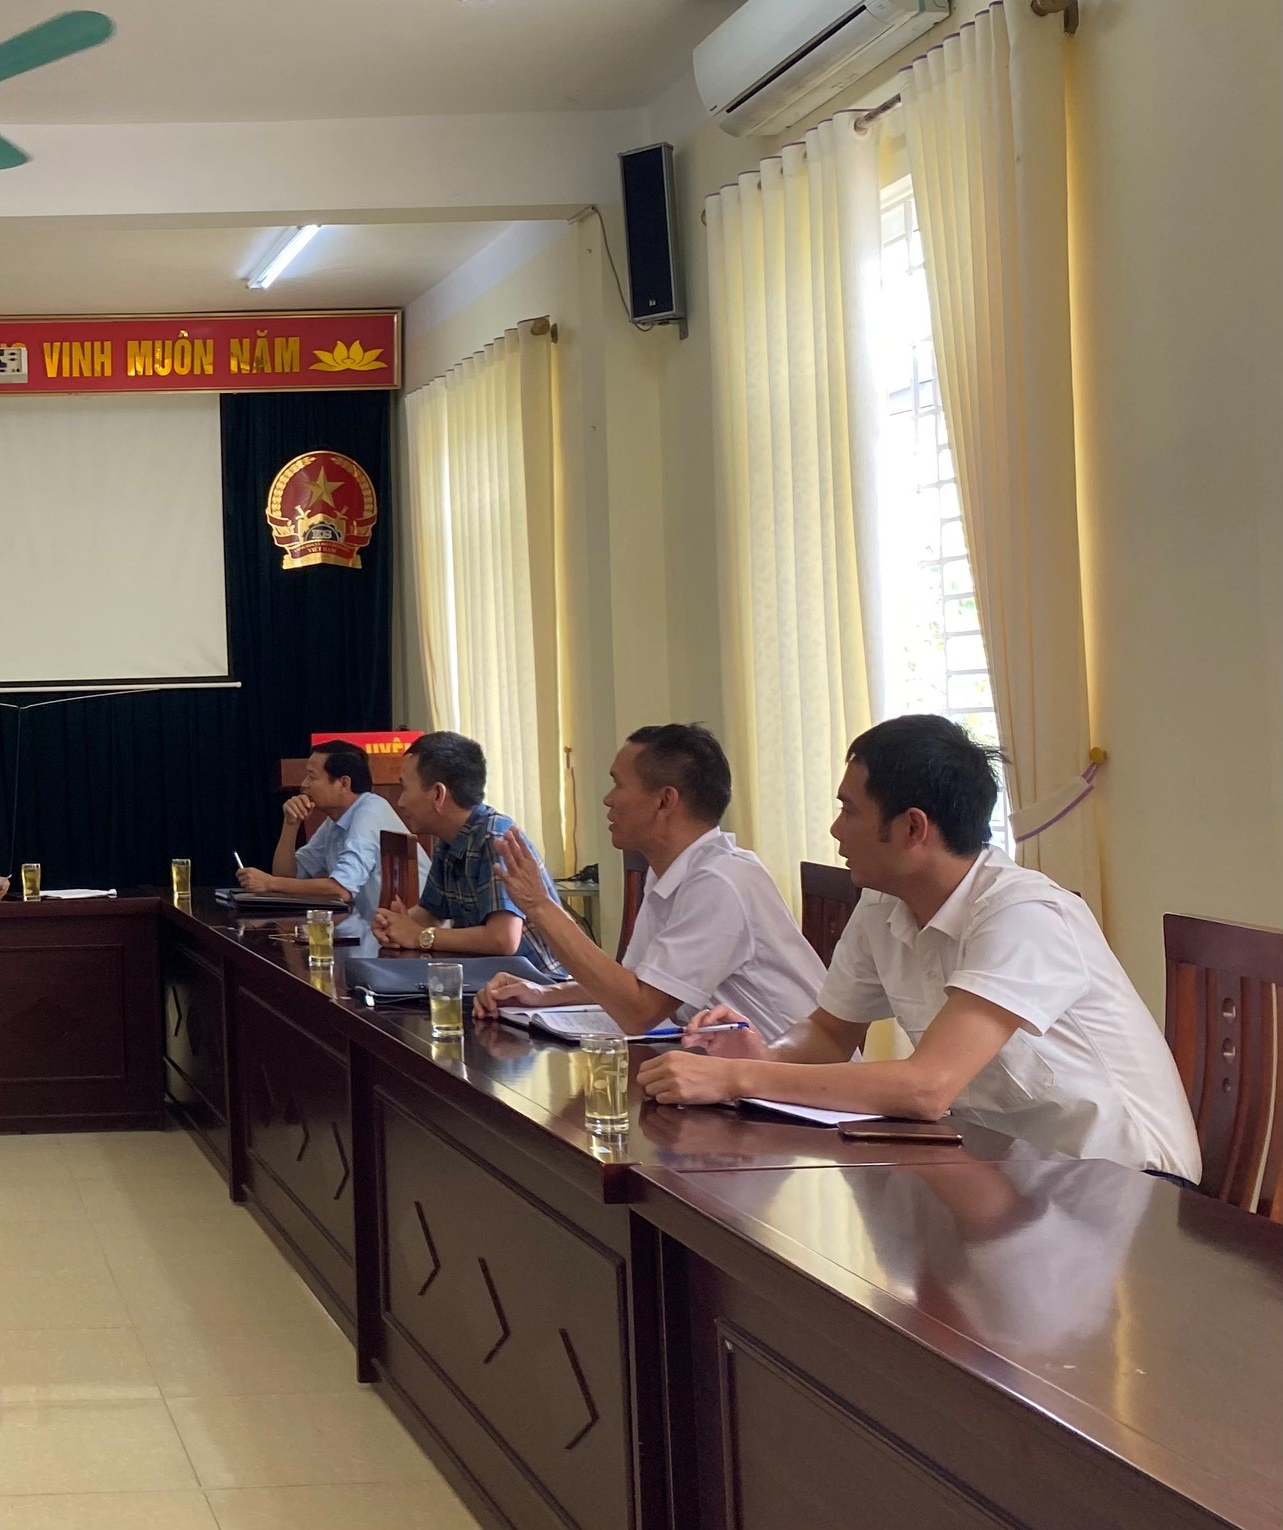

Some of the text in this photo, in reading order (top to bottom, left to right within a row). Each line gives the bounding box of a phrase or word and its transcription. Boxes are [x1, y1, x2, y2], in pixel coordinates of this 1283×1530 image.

[43, 340, 112, 378] VINH
[126, 328, 214, 377] MUÔN
[229, 328, 301, 375] NĂM
